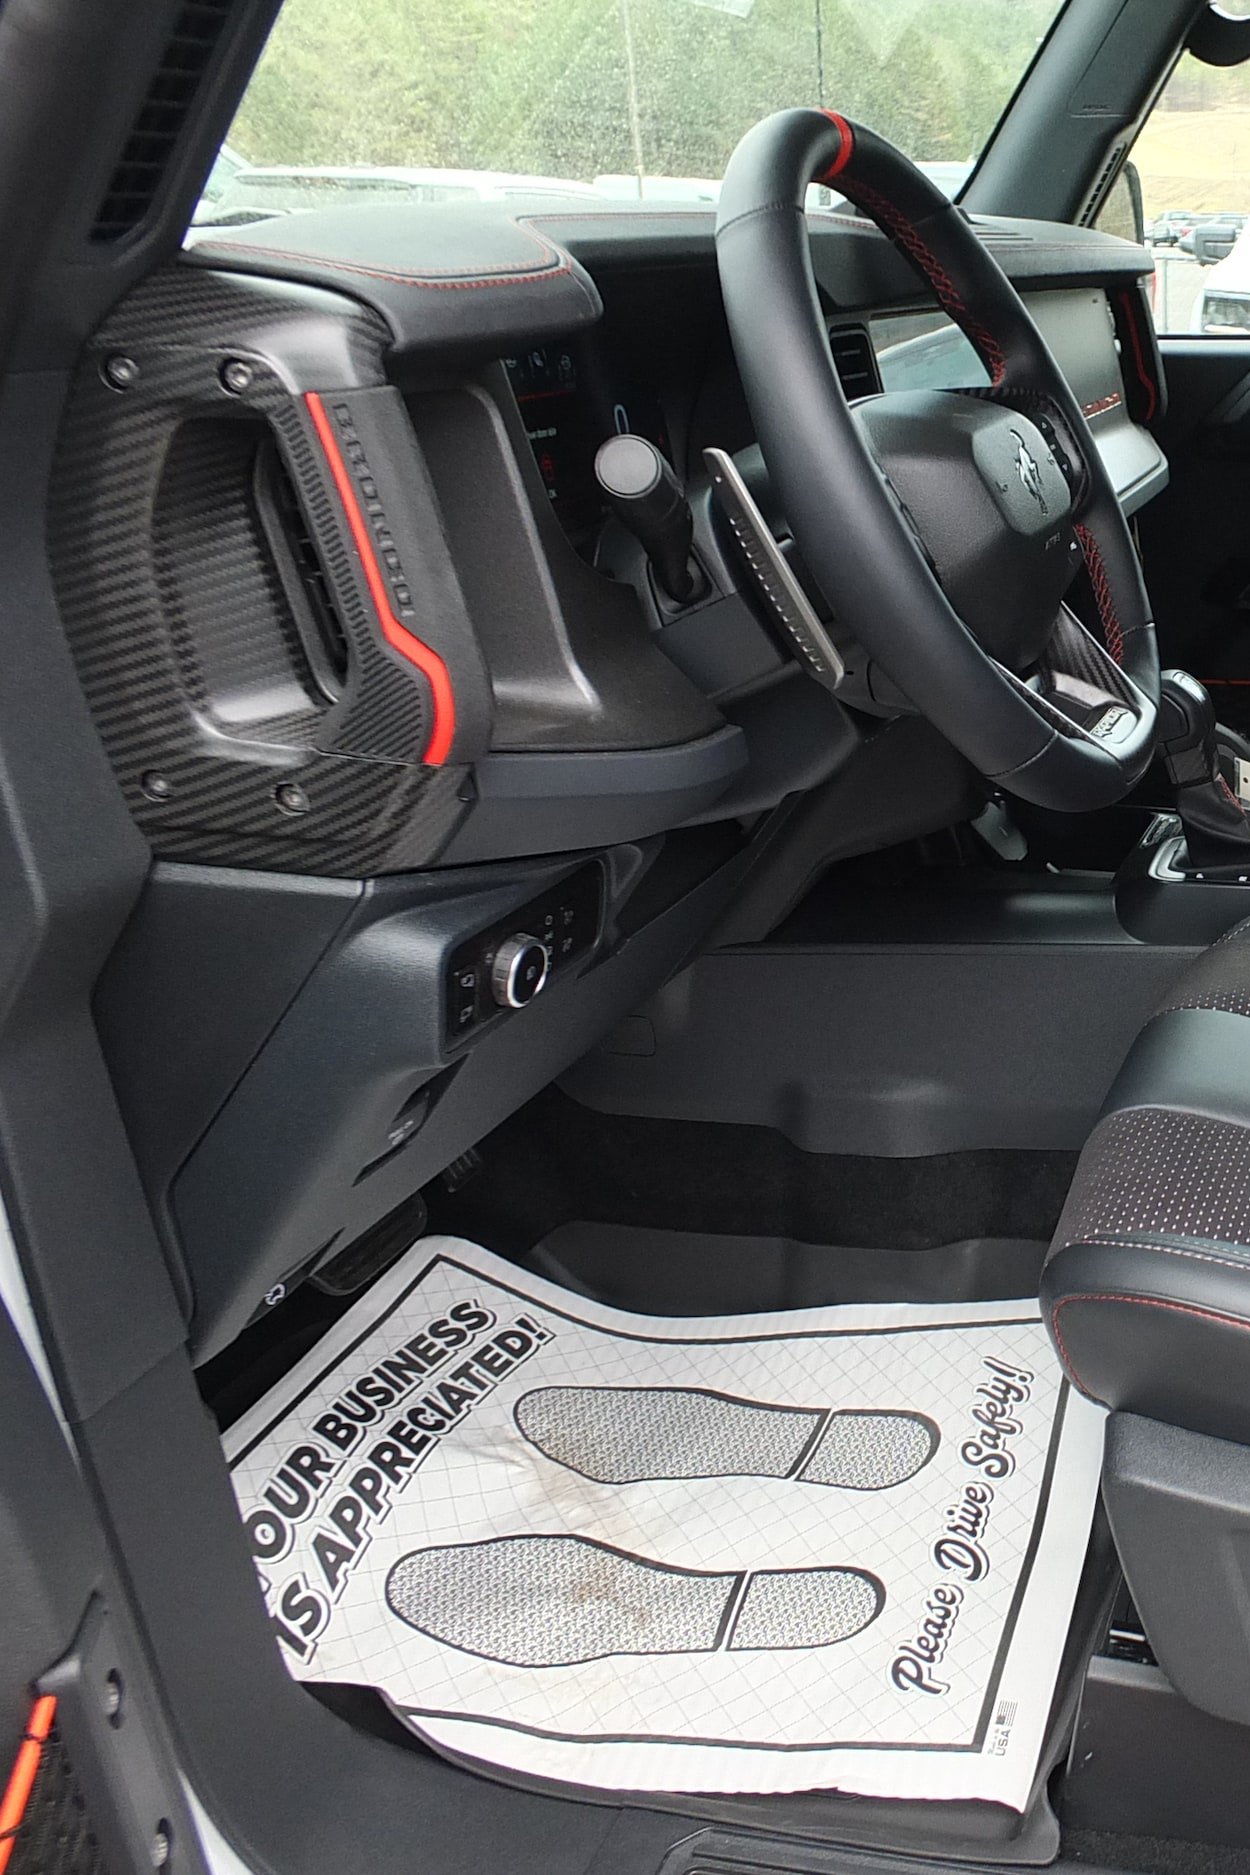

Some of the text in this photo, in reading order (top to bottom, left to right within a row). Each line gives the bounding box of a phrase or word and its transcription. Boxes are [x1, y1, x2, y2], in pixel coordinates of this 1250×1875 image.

[245, 1300, 494, 1562] OUR BUSINESS
[311, 1315, 552, 1597] APPRECIATED!
[892, 1356, 1033, 1696] Please Drive Safely!
[995, 1729, 1011, 1757] USA
